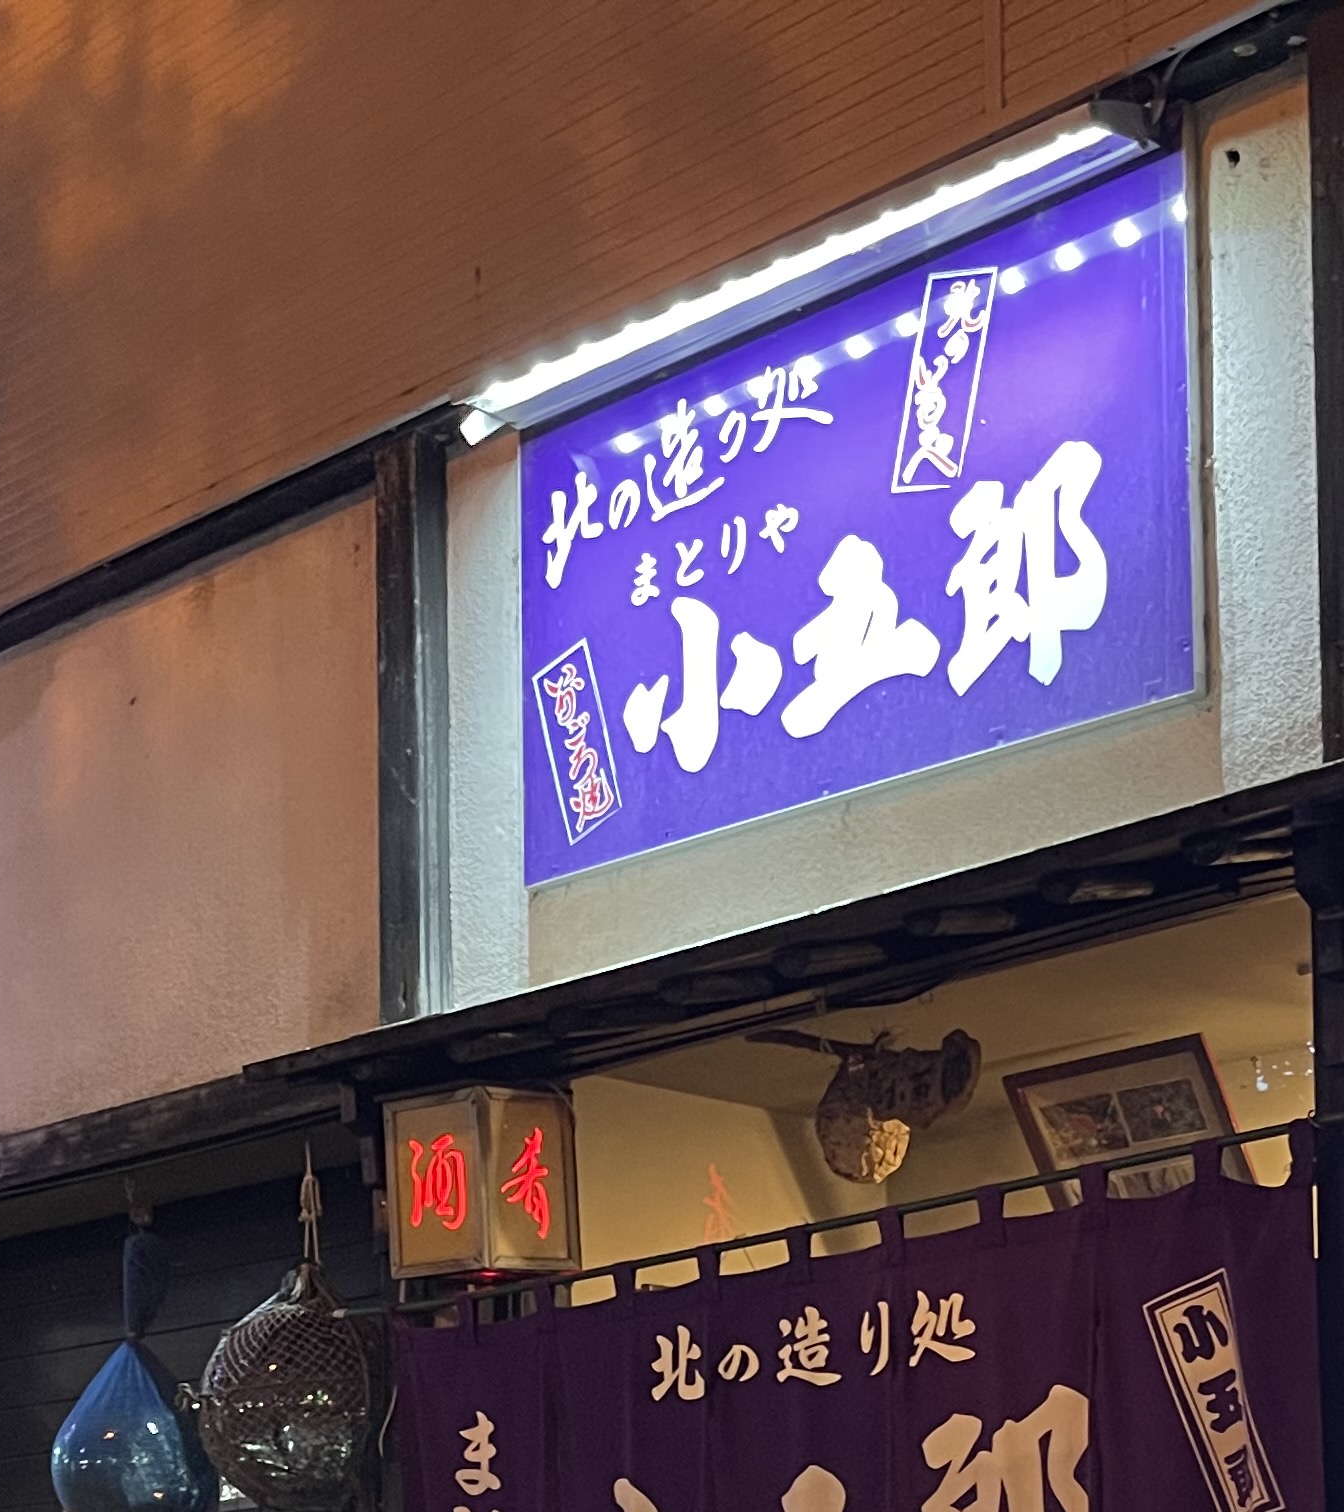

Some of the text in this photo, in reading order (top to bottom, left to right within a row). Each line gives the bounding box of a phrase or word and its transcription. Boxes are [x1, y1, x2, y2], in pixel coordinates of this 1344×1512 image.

[623, 440, 1108, 773] 小五郎
[630, 504, 800, 606] まとりや
[409, 1132, 467, 1230] 酒
[500, 1126, 552, 1240] 肴
[650, 1289, 977, 1401] 北の造り処
